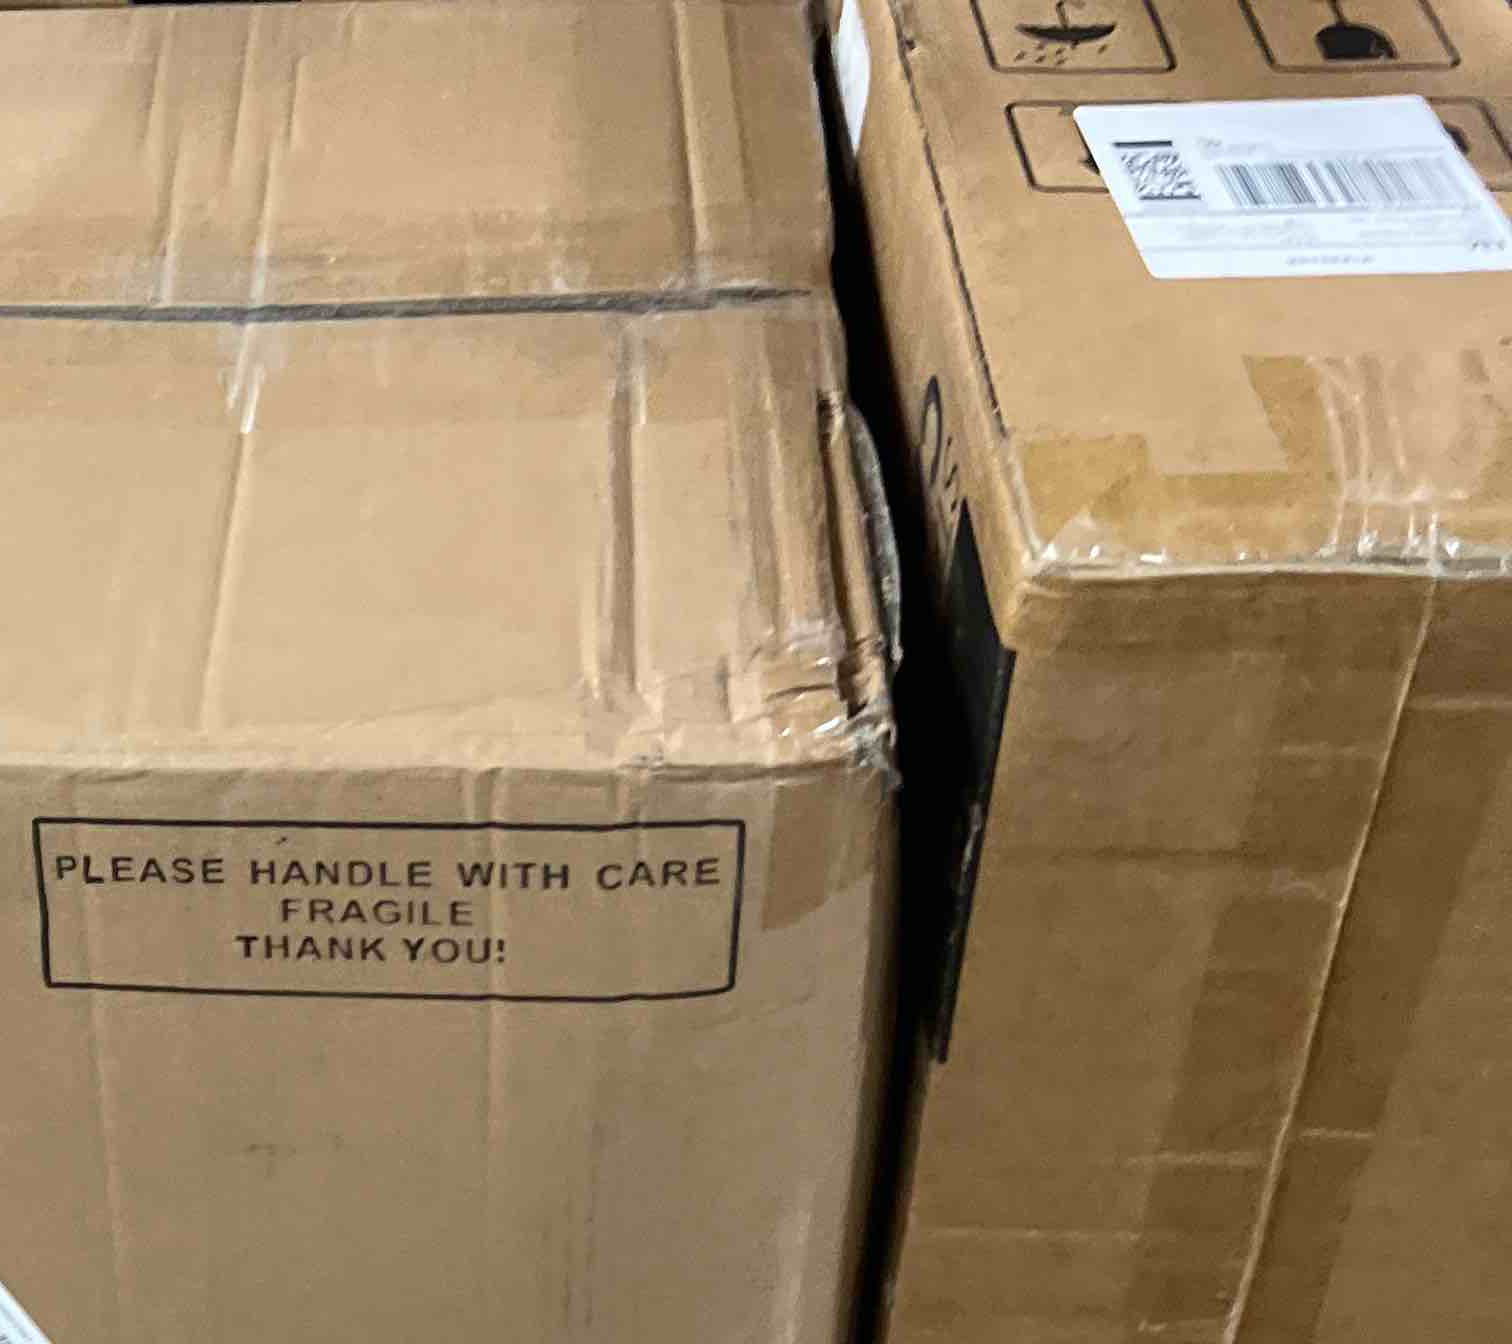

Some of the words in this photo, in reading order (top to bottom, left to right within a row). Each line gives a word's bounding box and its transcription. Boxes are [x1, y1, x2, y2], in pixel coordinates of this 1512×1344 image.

[54, 855, 226, 886] PLEASE
[249, 857, 433, 889] HANDLE
[456, 859, 571, 890] WITH
[596, 857, 722, 891] CARE
[280, 897, 475, 928] FRAGILE
[235, 934, 387, 962] THANK
[402, 936, 508, 965] YOU!
